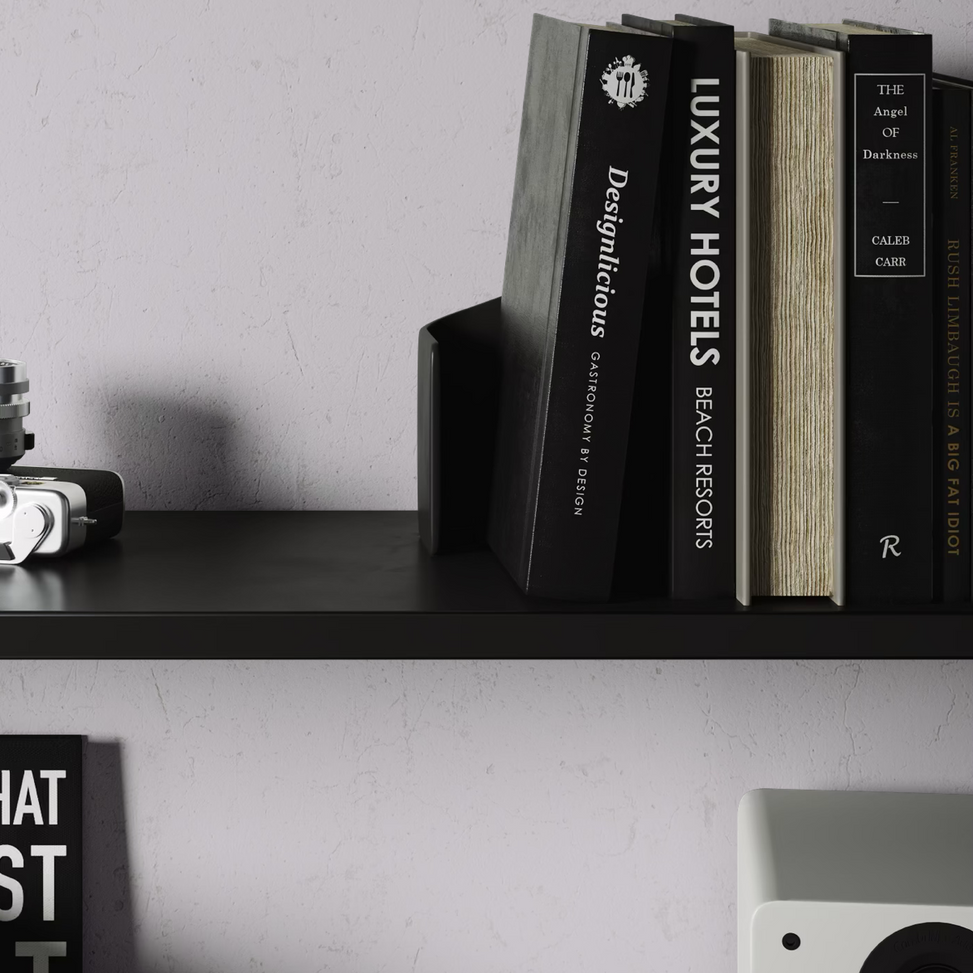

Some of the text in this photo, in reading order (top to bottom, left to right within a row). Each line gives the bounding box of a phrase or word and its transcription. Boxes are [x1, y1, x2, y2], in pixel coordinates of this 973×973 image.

[876, 84, 905, 95] THE
[873, 106, 908, 118] Angel
[882, 127, 900, 138] OF
[862, 148, 918, 160] Darkness
[949, 126, 959, 200] AL FRANKEN
[689, 78, 721, 367] LUXURY HOTELS
[871, 235, 910, 246] CALEB
[590, 165, 629, 339] Designlicious
[875, 256, 906, 267] CARR
[947, 238, 960, 556] RUSH LIMBAUGH IS A BIG FAT IDIOT
[573, 351, 601, 516] GASTRONOMY BY DESIGN
[695, 387, 713, 549] BEACH RESORTS
